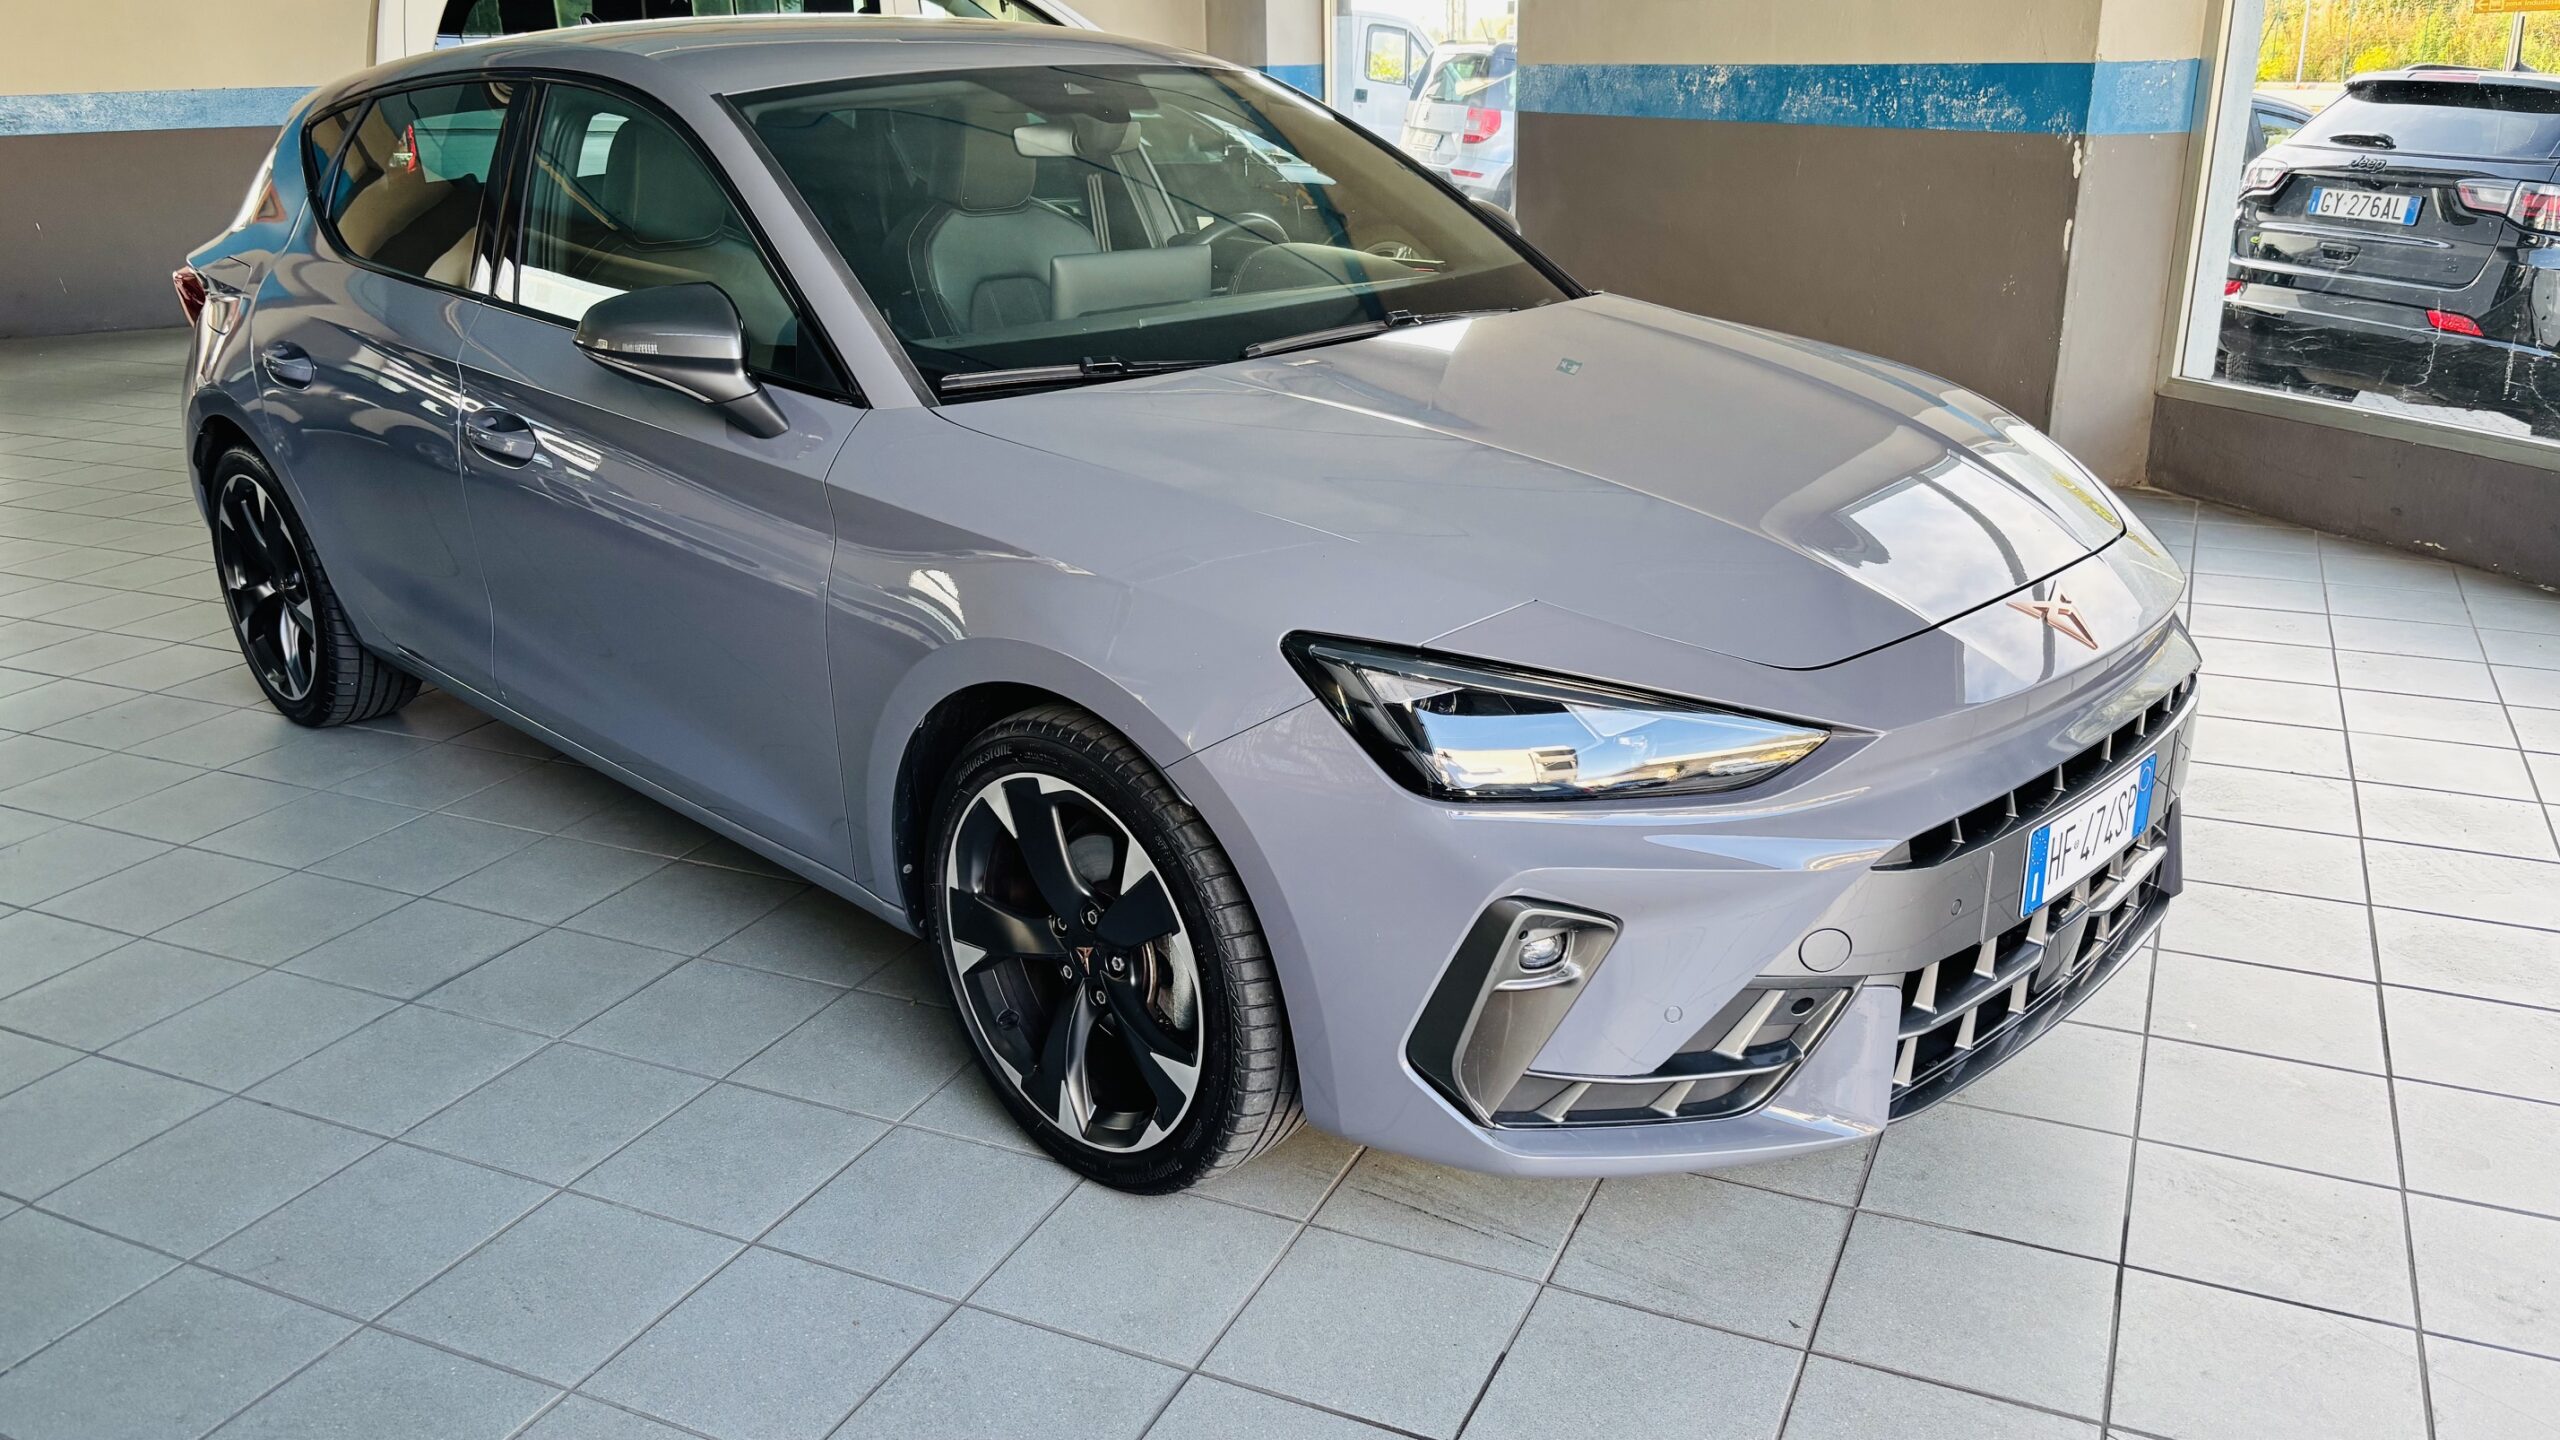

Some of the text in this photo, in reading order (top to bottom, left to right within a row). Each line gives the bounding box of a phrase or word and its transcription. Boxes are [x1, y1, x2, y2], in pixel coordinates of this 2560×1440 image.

[2350, 155, 2387, 173] Jeep
[2320, 191, 2401, 220] GY 276AL
[2047, 783, 2138, 885] HF 474SP
